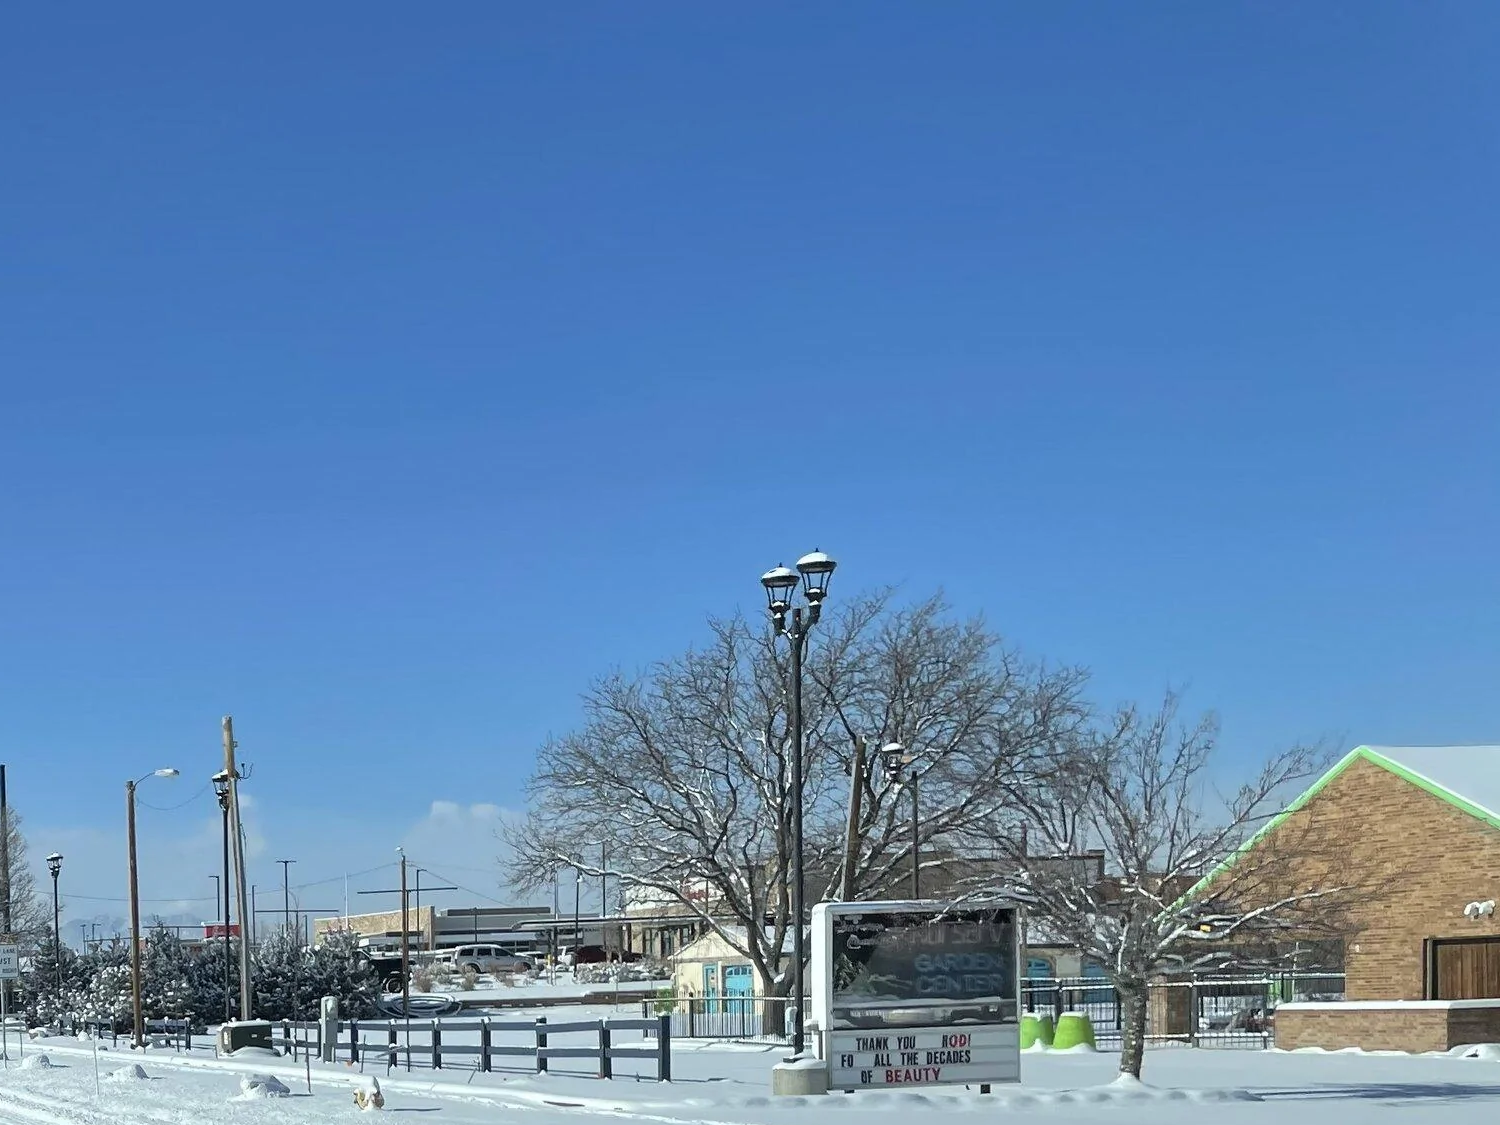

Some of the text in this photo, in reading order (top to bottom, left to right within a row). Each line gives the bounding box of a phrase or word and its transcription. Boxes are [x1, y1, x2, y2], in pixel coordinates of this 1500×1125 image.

[914, 952, 1004, 973] GARDEN
[914, 974, 1004, 993] CENTER
[856, 1036, 889, 1051] THANK
[897, 1035, 916, 1050] YOU
[873, 1053, 892, 1067] ALL
[900, 1052, 919, 1066] THE
[926, 1050, 971, 1065] DECADES
[860, 1067, 941, 1084] OF BEAUTY
